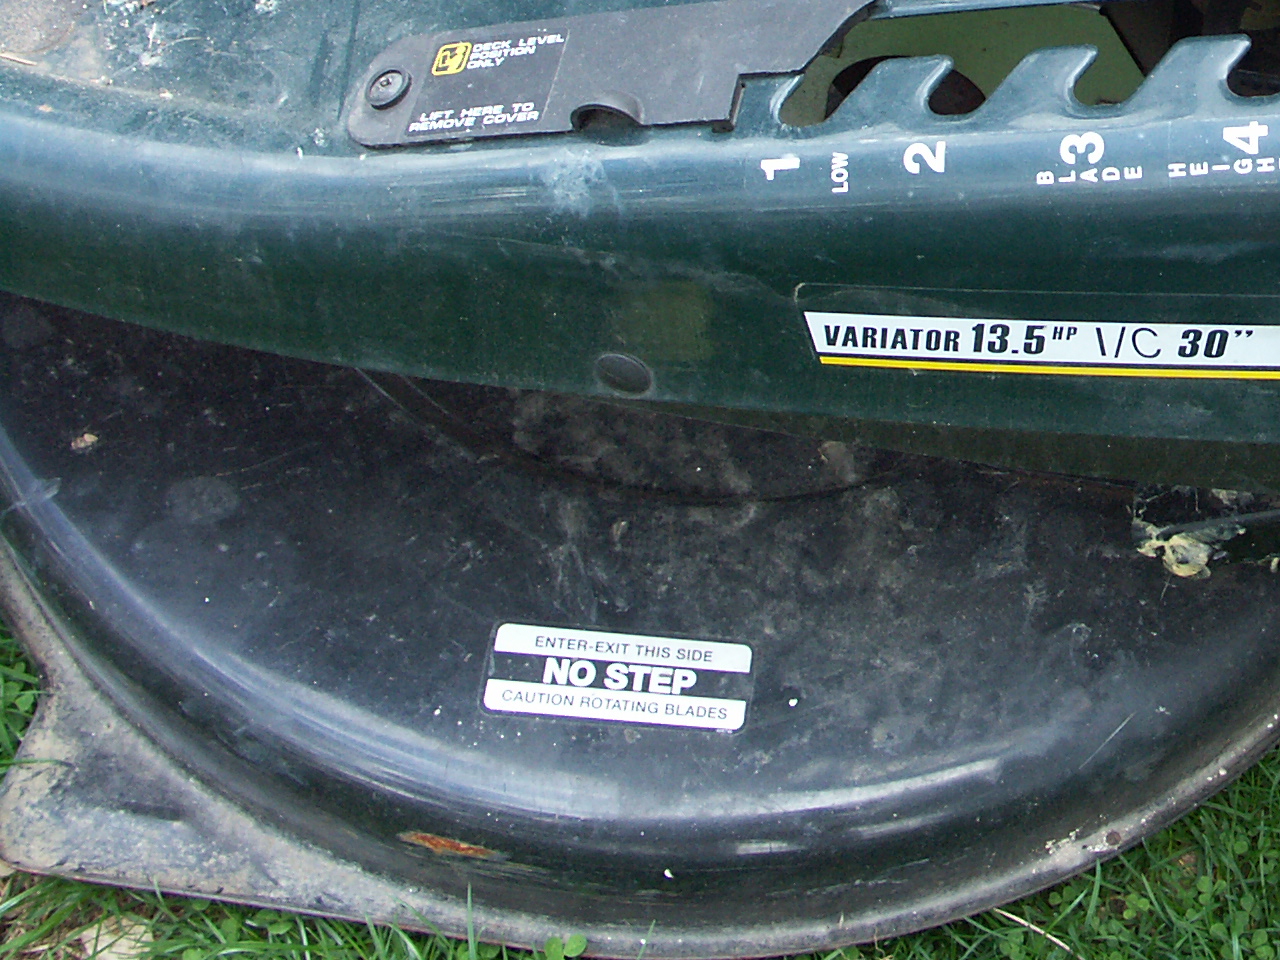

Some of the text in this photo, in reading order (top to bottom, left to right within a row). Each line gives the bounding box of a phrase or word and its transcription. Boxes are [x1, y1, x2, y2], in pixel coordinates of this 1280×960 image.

[469, 45, 537, 60] POSITION
[473, 34, 565, 53] DECK LEVEL
[466, 57, 505, 70] ONLY
[408, 110, 540, 132] REMOVE COVER
[419, 101, 535, 123] LIFT HERE TO
[1060, 131, 1105, 165] 3
[1223, 121, 1269, 155] 4
[760, 157, 800, 181] 1
[903, 140, 947, 174] 2
[830, 151, 849, 194] LOW
[1036, 165, 1143, 185] BLADE
[824, 324, 961, 352] VARIATOR
[534, 635, 713, 663] ENTER-EXIT THIS SIDE
[541, 657, 698, 695] NO STEP
[501, 689, 729, 721] CAUTION ROTATING BLADES
